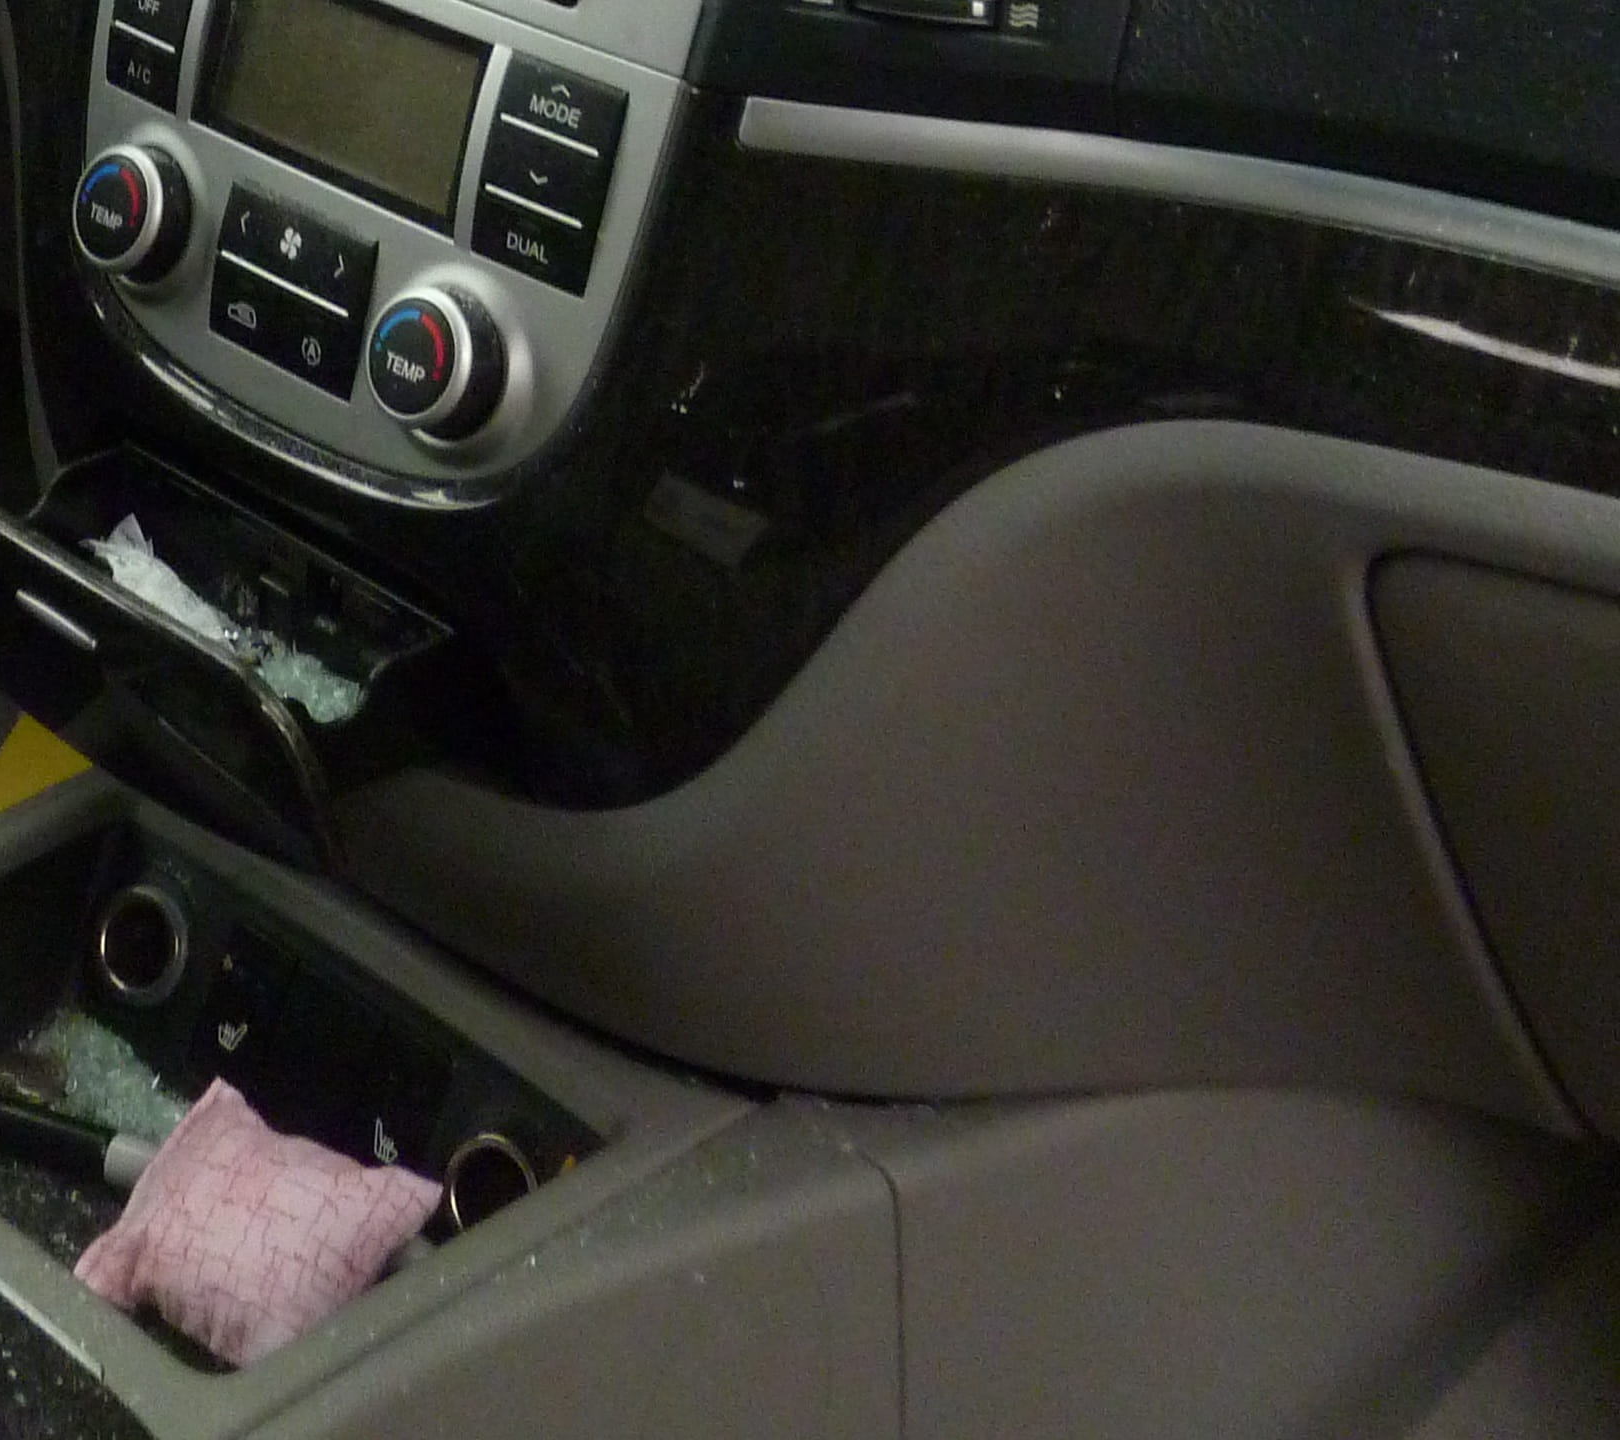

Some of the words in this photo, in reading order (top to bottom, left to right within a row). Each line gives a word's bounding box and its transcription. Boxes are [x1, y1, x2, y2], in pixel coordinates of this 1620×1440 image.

[126, 62, 152, 85] A/C
[528, 96, 581, 128] MODE
[89, 204, 123, 230] TEMP
[505, 232, 549, 266] DUAL
[386, 351, 426, 385] TEMP
